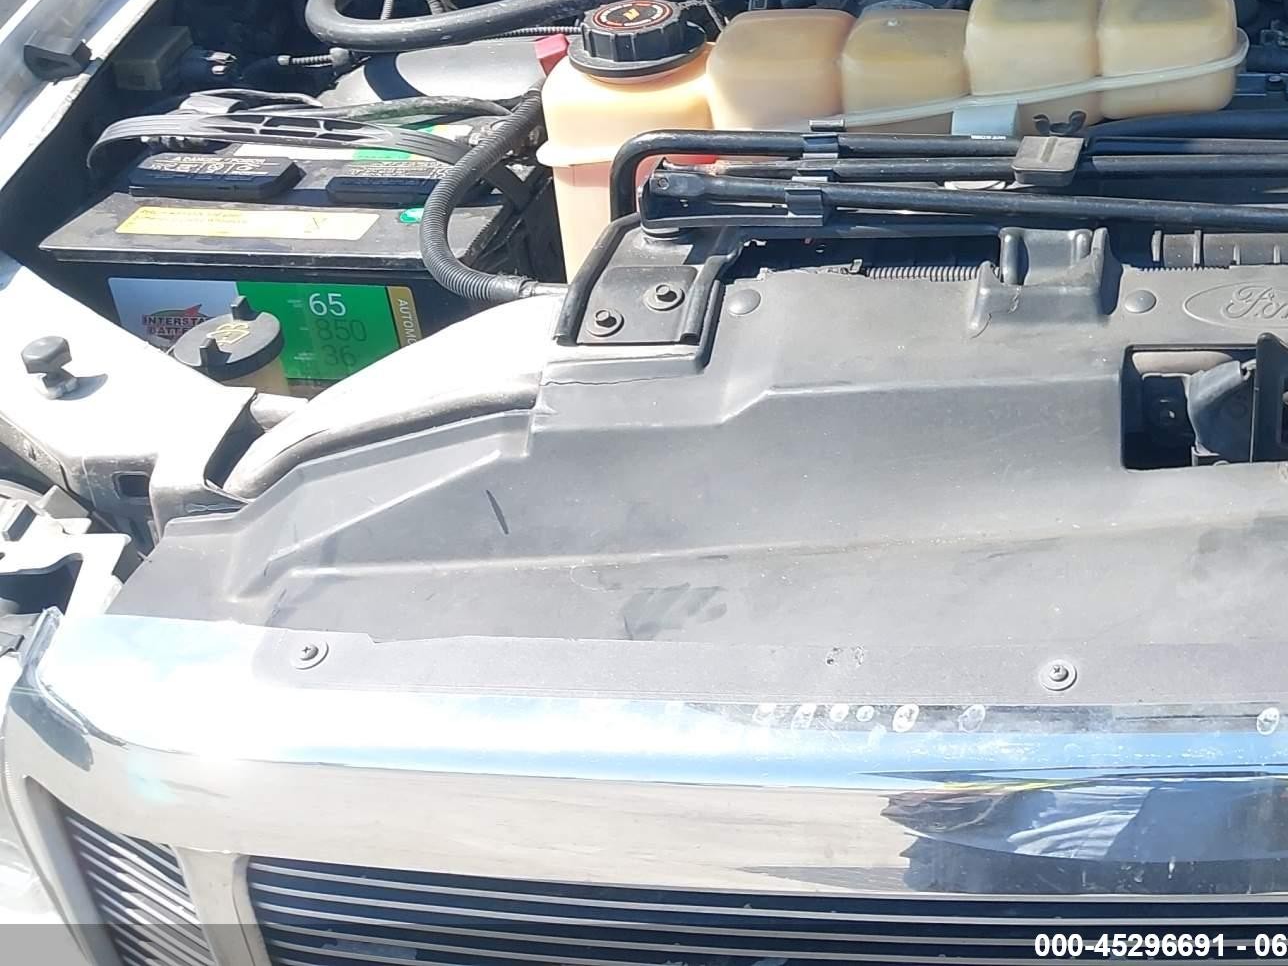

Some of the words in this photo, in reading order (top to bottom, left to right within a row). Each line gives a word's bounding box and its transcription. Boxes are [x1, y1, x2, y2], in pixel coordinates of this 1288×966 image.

[308, 292, 347, 317] 65
[143, 315, 207, 326] INTERSTA
[315, 318, 368, 342] 850
[320, 344, 358, 368] 36
